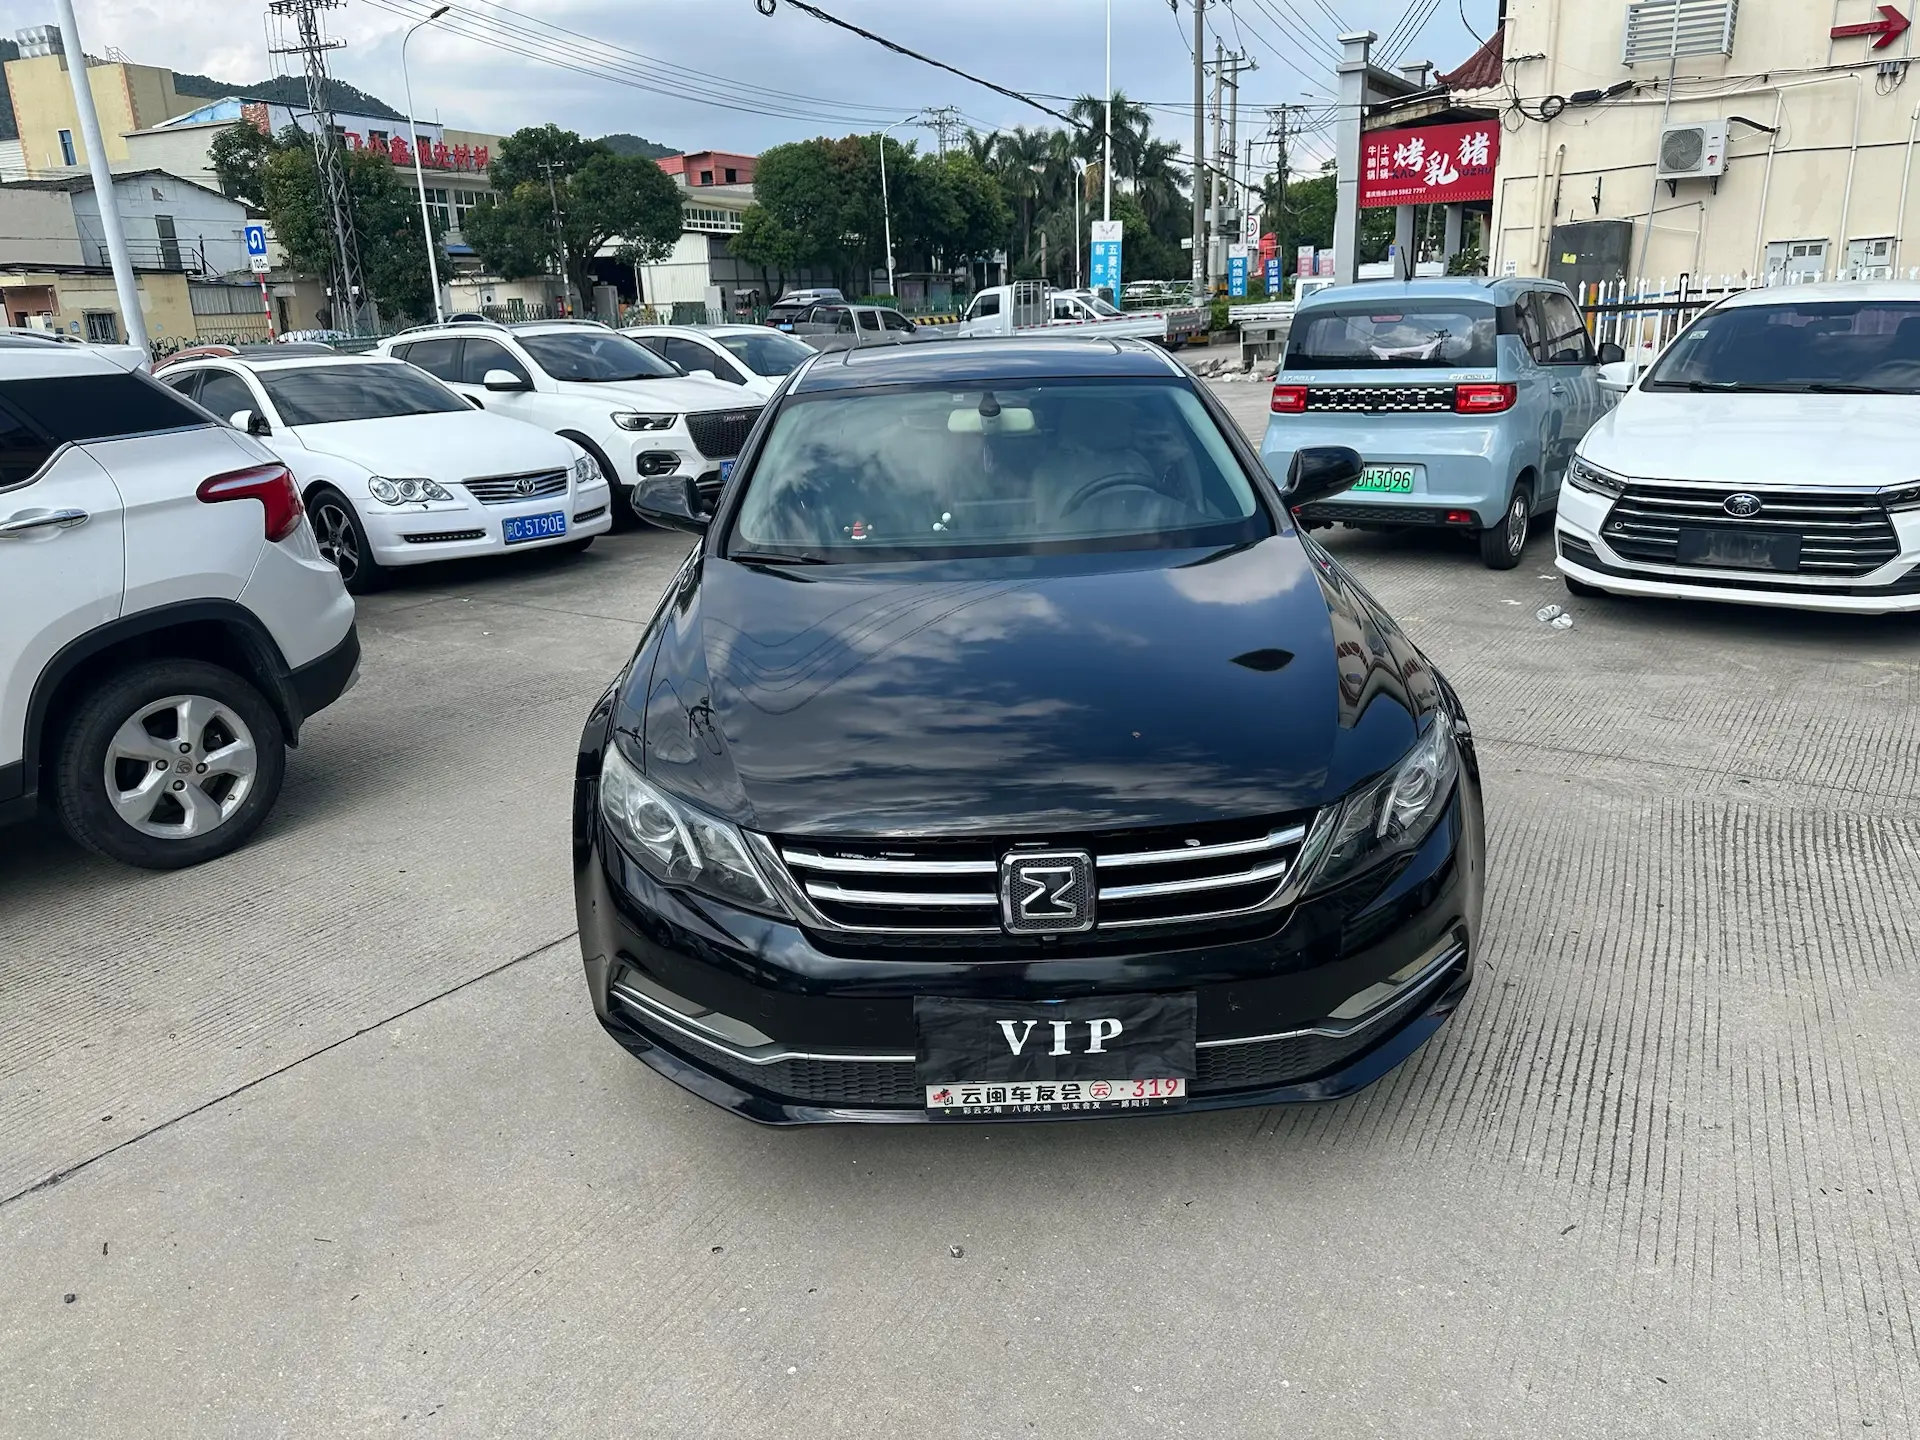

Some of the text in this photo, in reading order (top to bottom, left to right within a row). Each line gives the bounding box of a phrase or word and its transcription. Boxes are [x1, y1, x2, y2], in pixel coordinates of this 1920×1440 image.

[1393, 132, 1490, 186] 烤乳猪
[1107, 244, 1118, 297] 五菱汽车
[996, 1017, 1124, 1056] VIP
[961, 1084, 1082, 1104] 云闽车友会
[963, 1098, 1150, 1115] 彩云之南 八闽大地 以车会友 一路同行
